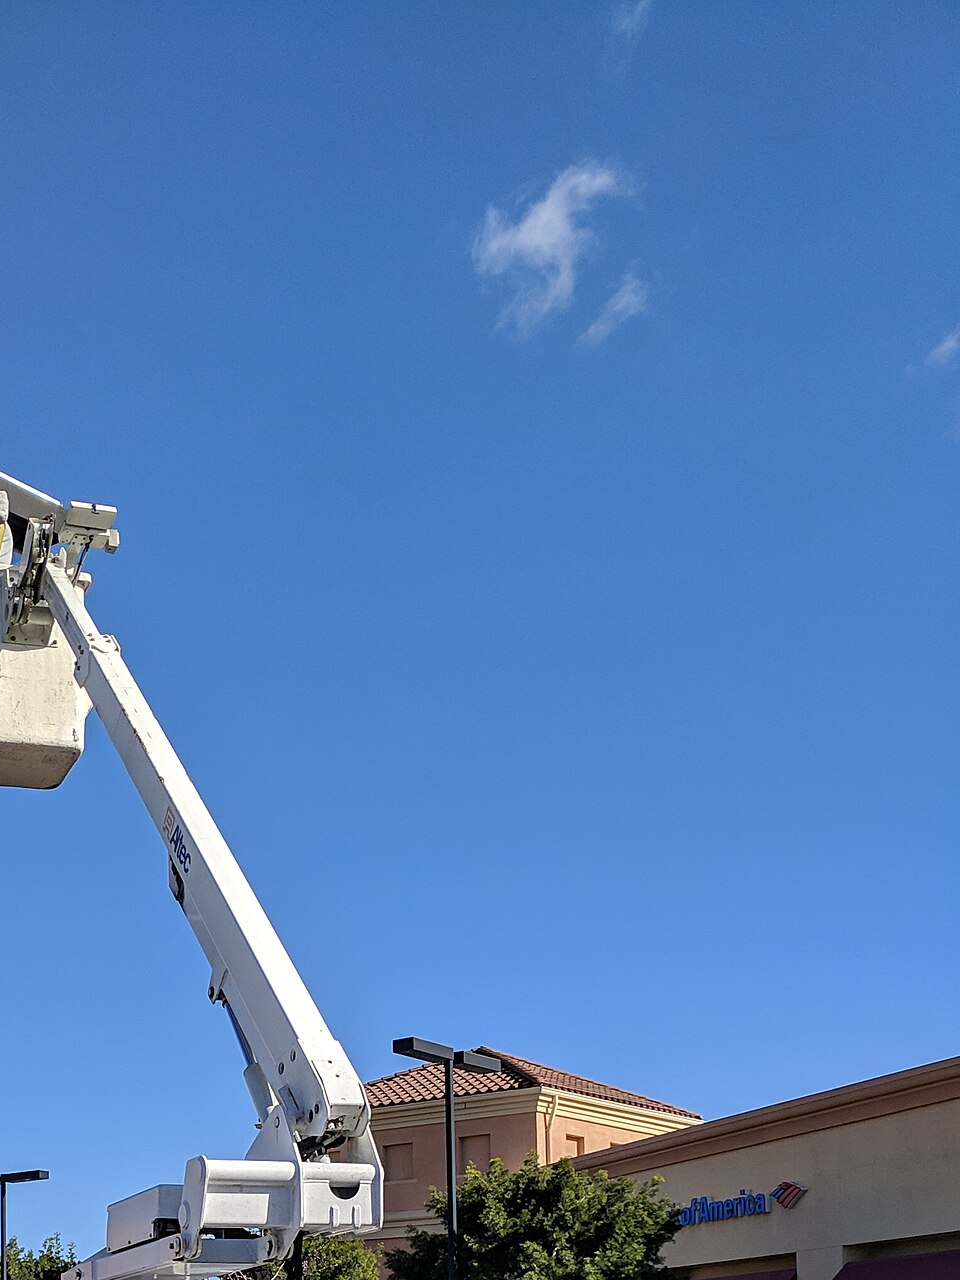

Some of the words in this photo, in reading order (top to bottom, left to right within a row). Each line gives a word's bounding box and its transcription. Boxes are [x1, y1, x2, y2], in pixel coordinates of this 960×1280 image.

[170, 825, 191, 873] Altec
[680, 1198, 699, 1227] of
[698, 1189, 767, 1222] America
